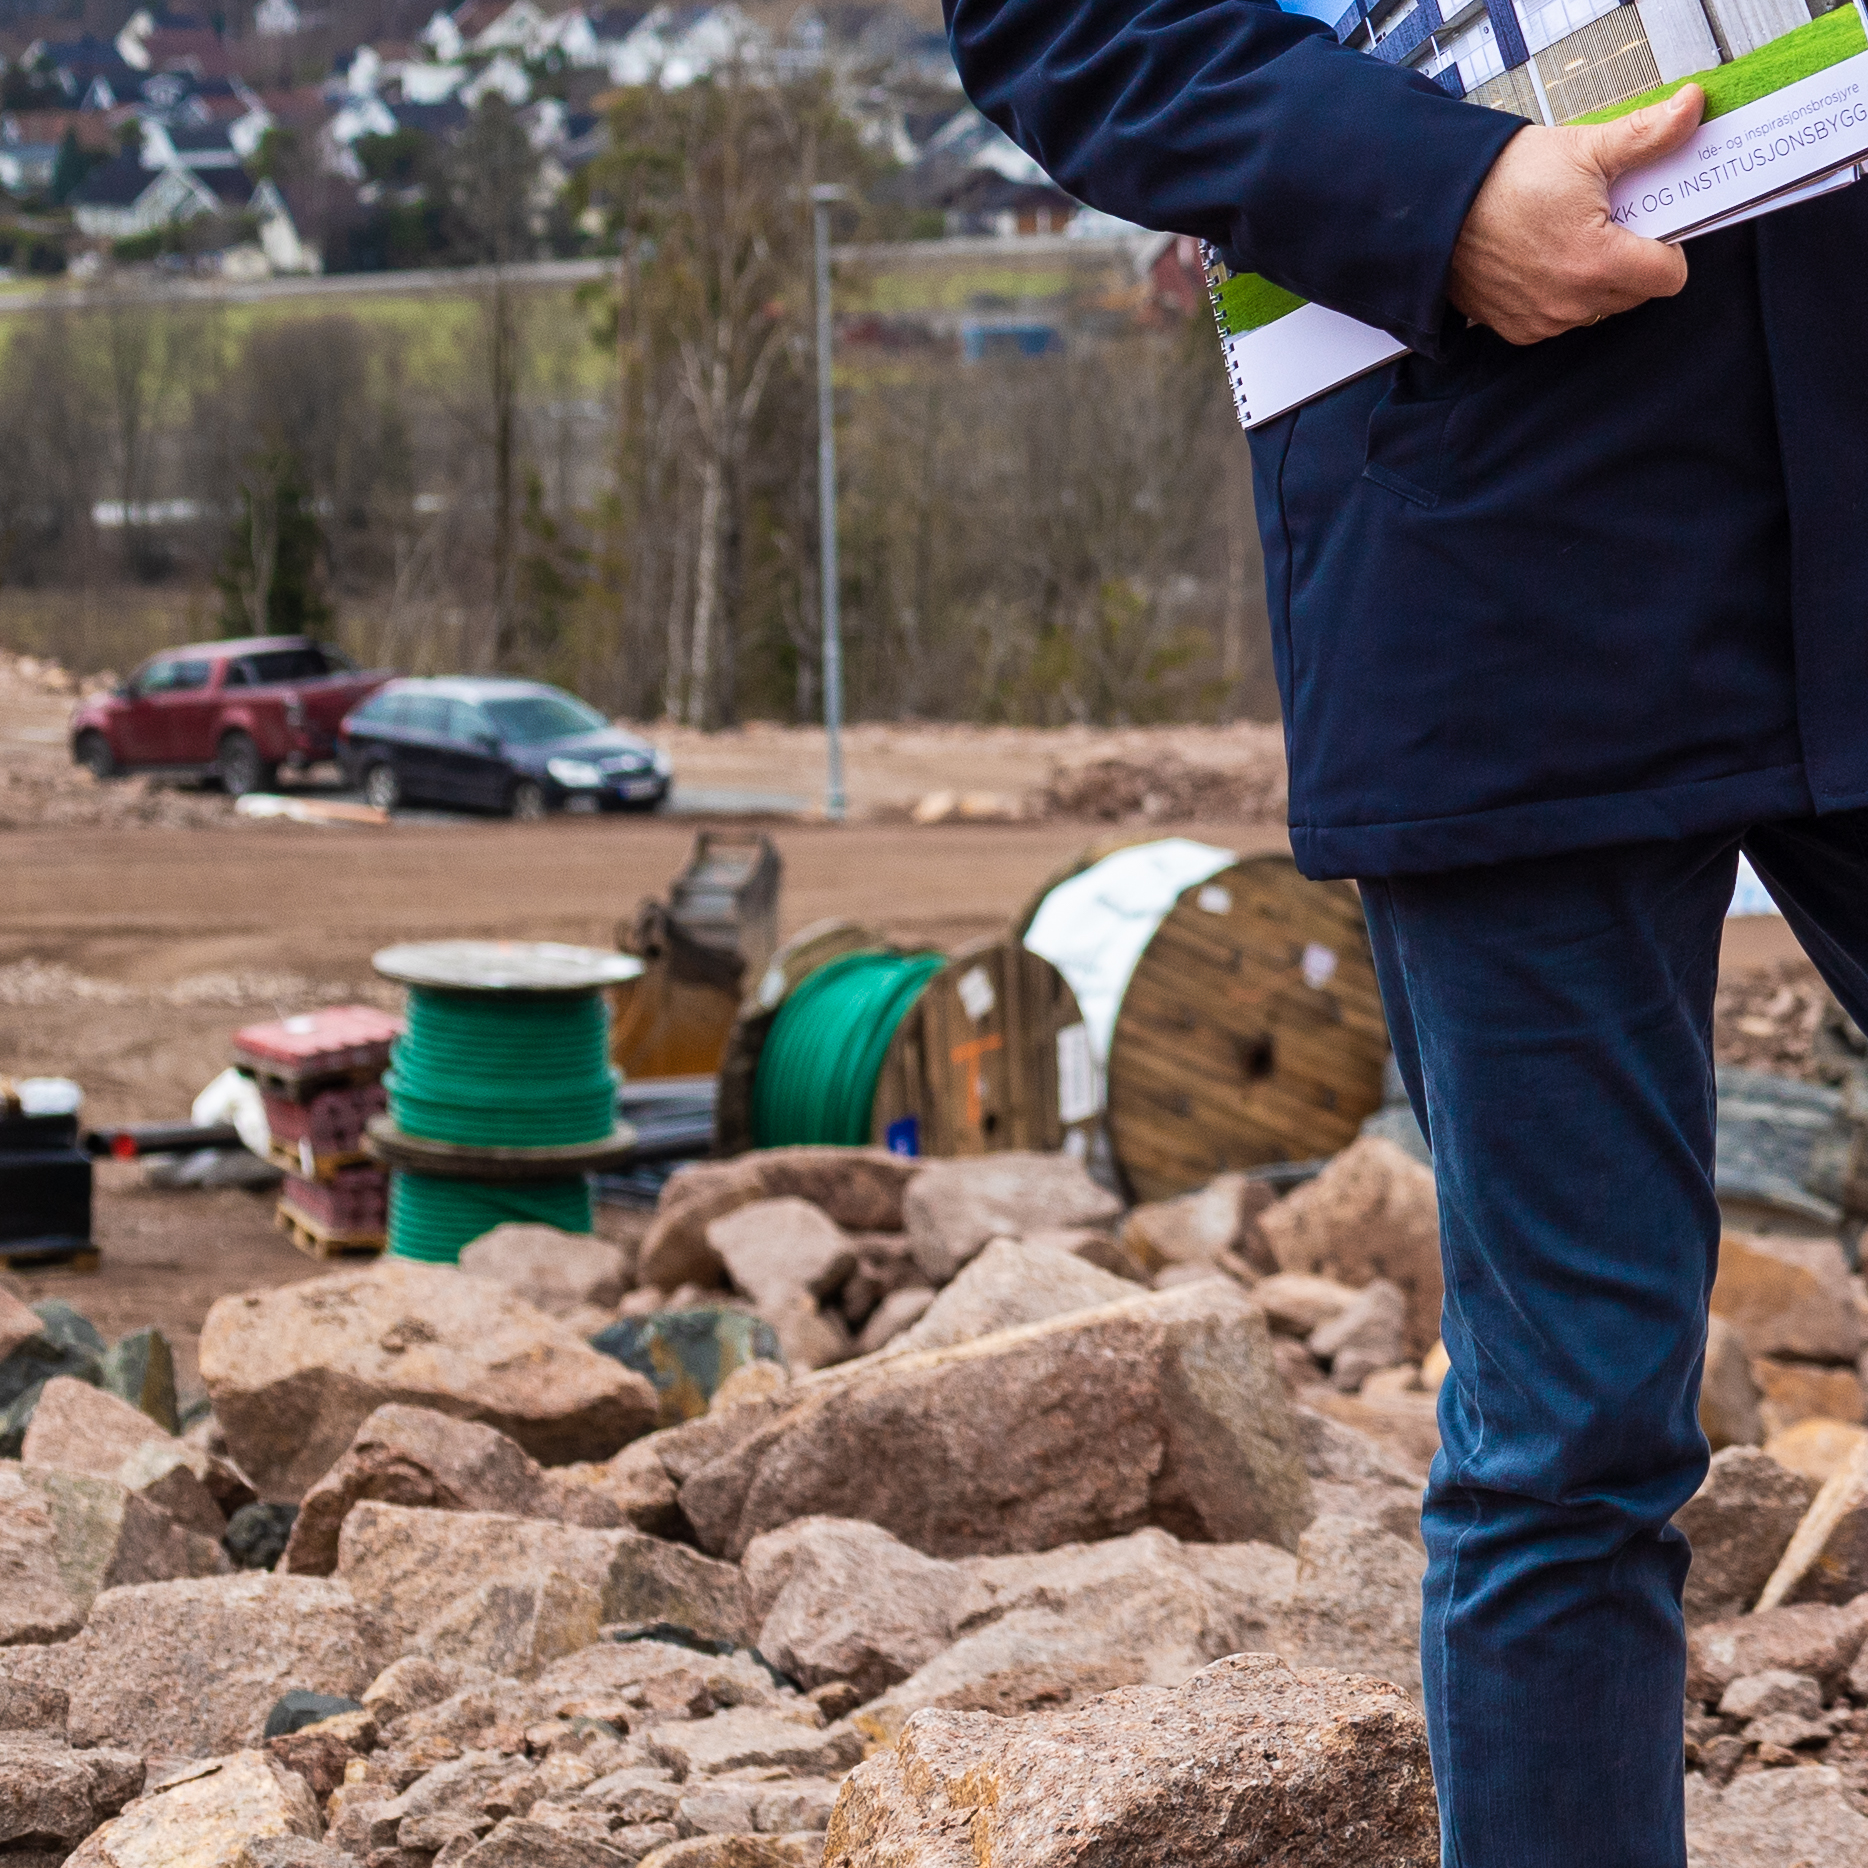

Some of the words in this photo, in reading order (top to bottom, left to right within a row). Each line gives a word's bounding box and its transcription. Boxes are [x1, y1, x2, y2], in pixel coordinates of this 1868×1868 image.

[1642, 187, 1674, 213] OG
[1678, 103, 1868, 199] INSTITUSJONSBYGG
[1726, 136, 1743, 149] og
[1743, 83, 1860, 141] inspirasjonsbrosjyre
